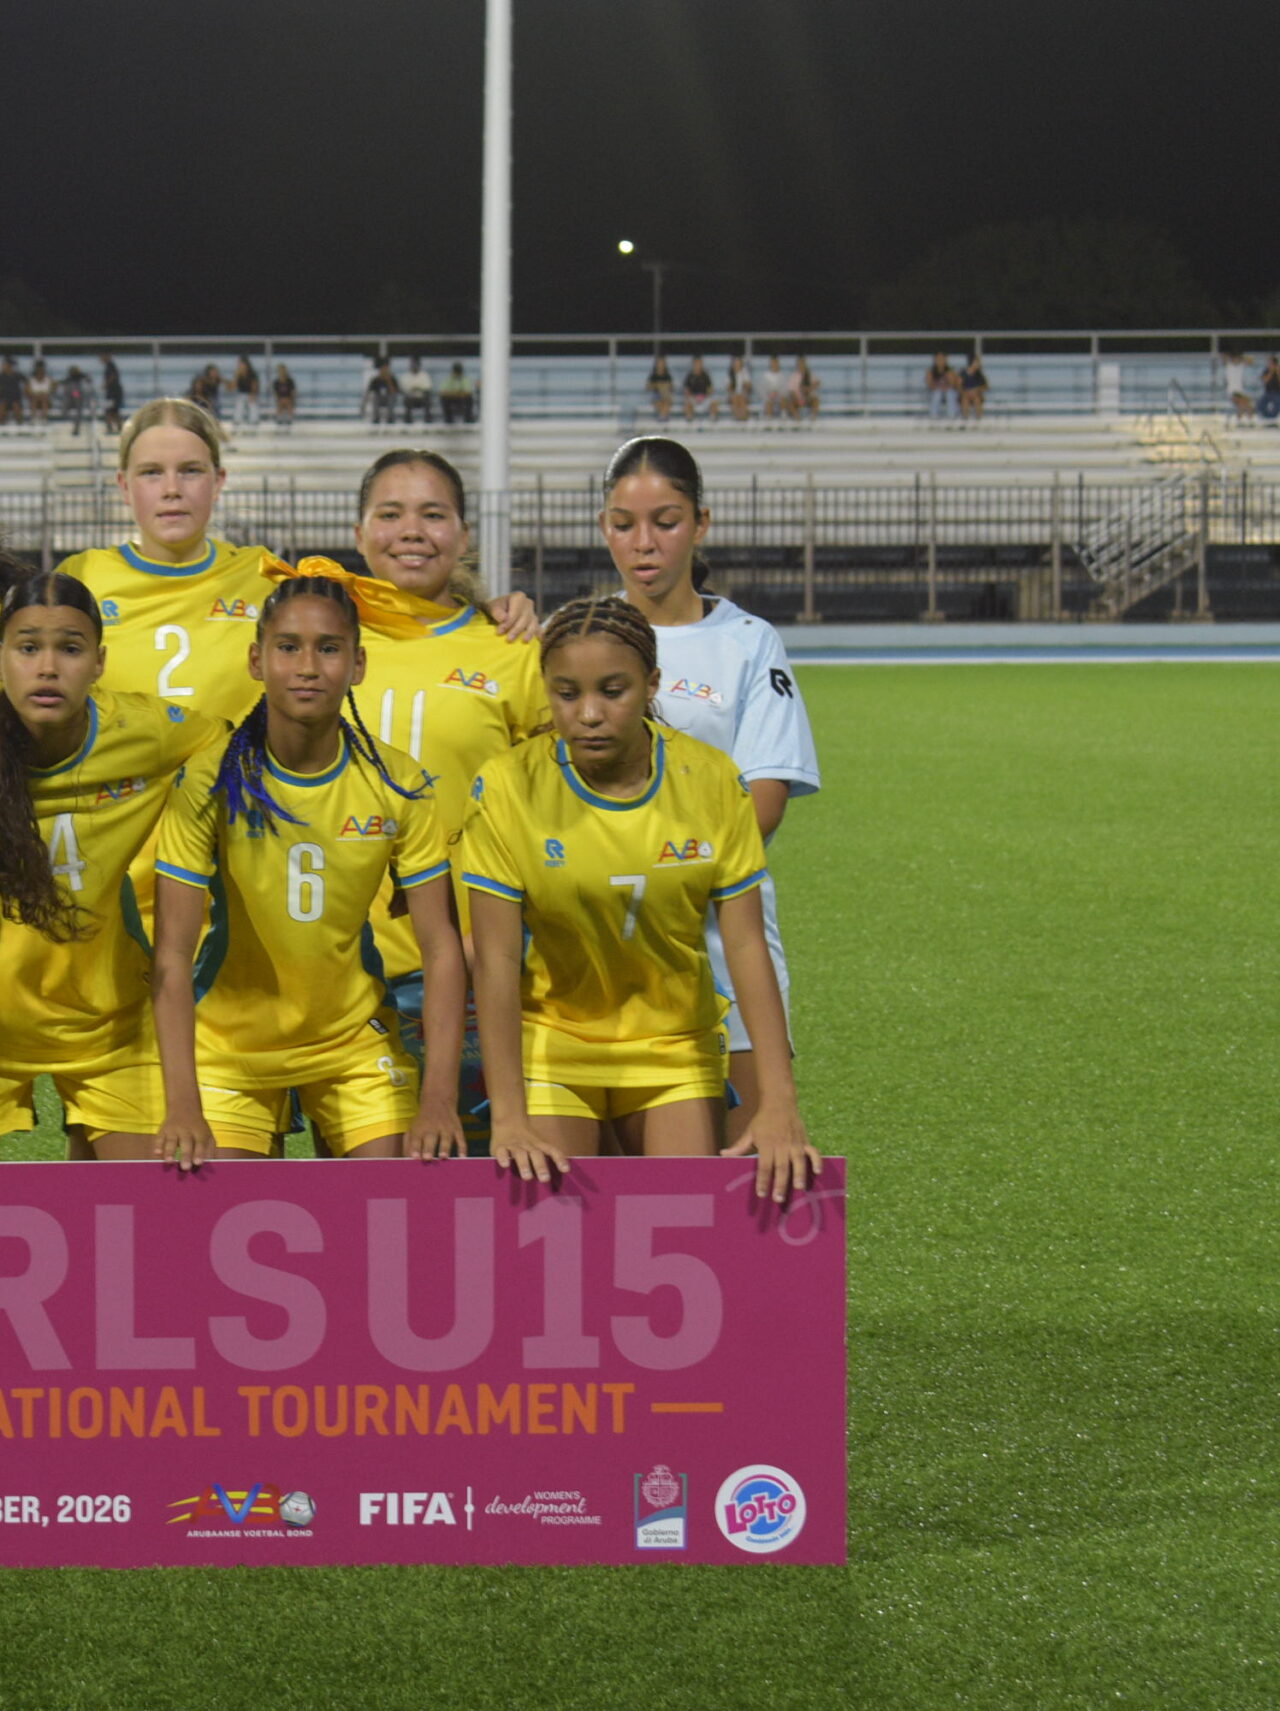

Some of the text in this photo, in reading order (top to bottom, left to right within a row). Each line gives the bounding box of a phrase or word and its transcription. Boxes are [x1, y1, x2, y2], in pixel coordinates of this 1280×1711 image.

[154, 624, 195, 697] 2
[380, 688, 425, 762] 11
[49, 812, 87, 891] 4
[287, 842, 325, 922] 6
[609, 875, 647, 941] 7
[367, 1194, 723, 1373] U15
[237, 1383, 635, 1437] TOURNAMENT
[57, 1495, 131, 1523] 2026
[360, 1492, 457, 1525] FIFA
[485, 1495, 586, 1519] development
[534, 1491, 581, 1500] WOMEN'S
[541, 1515, 602, 1525] PROGRAMME
[243, 1529, 285, 1538] VOETBAL
[286, 1529, 314, 1538] BOND
